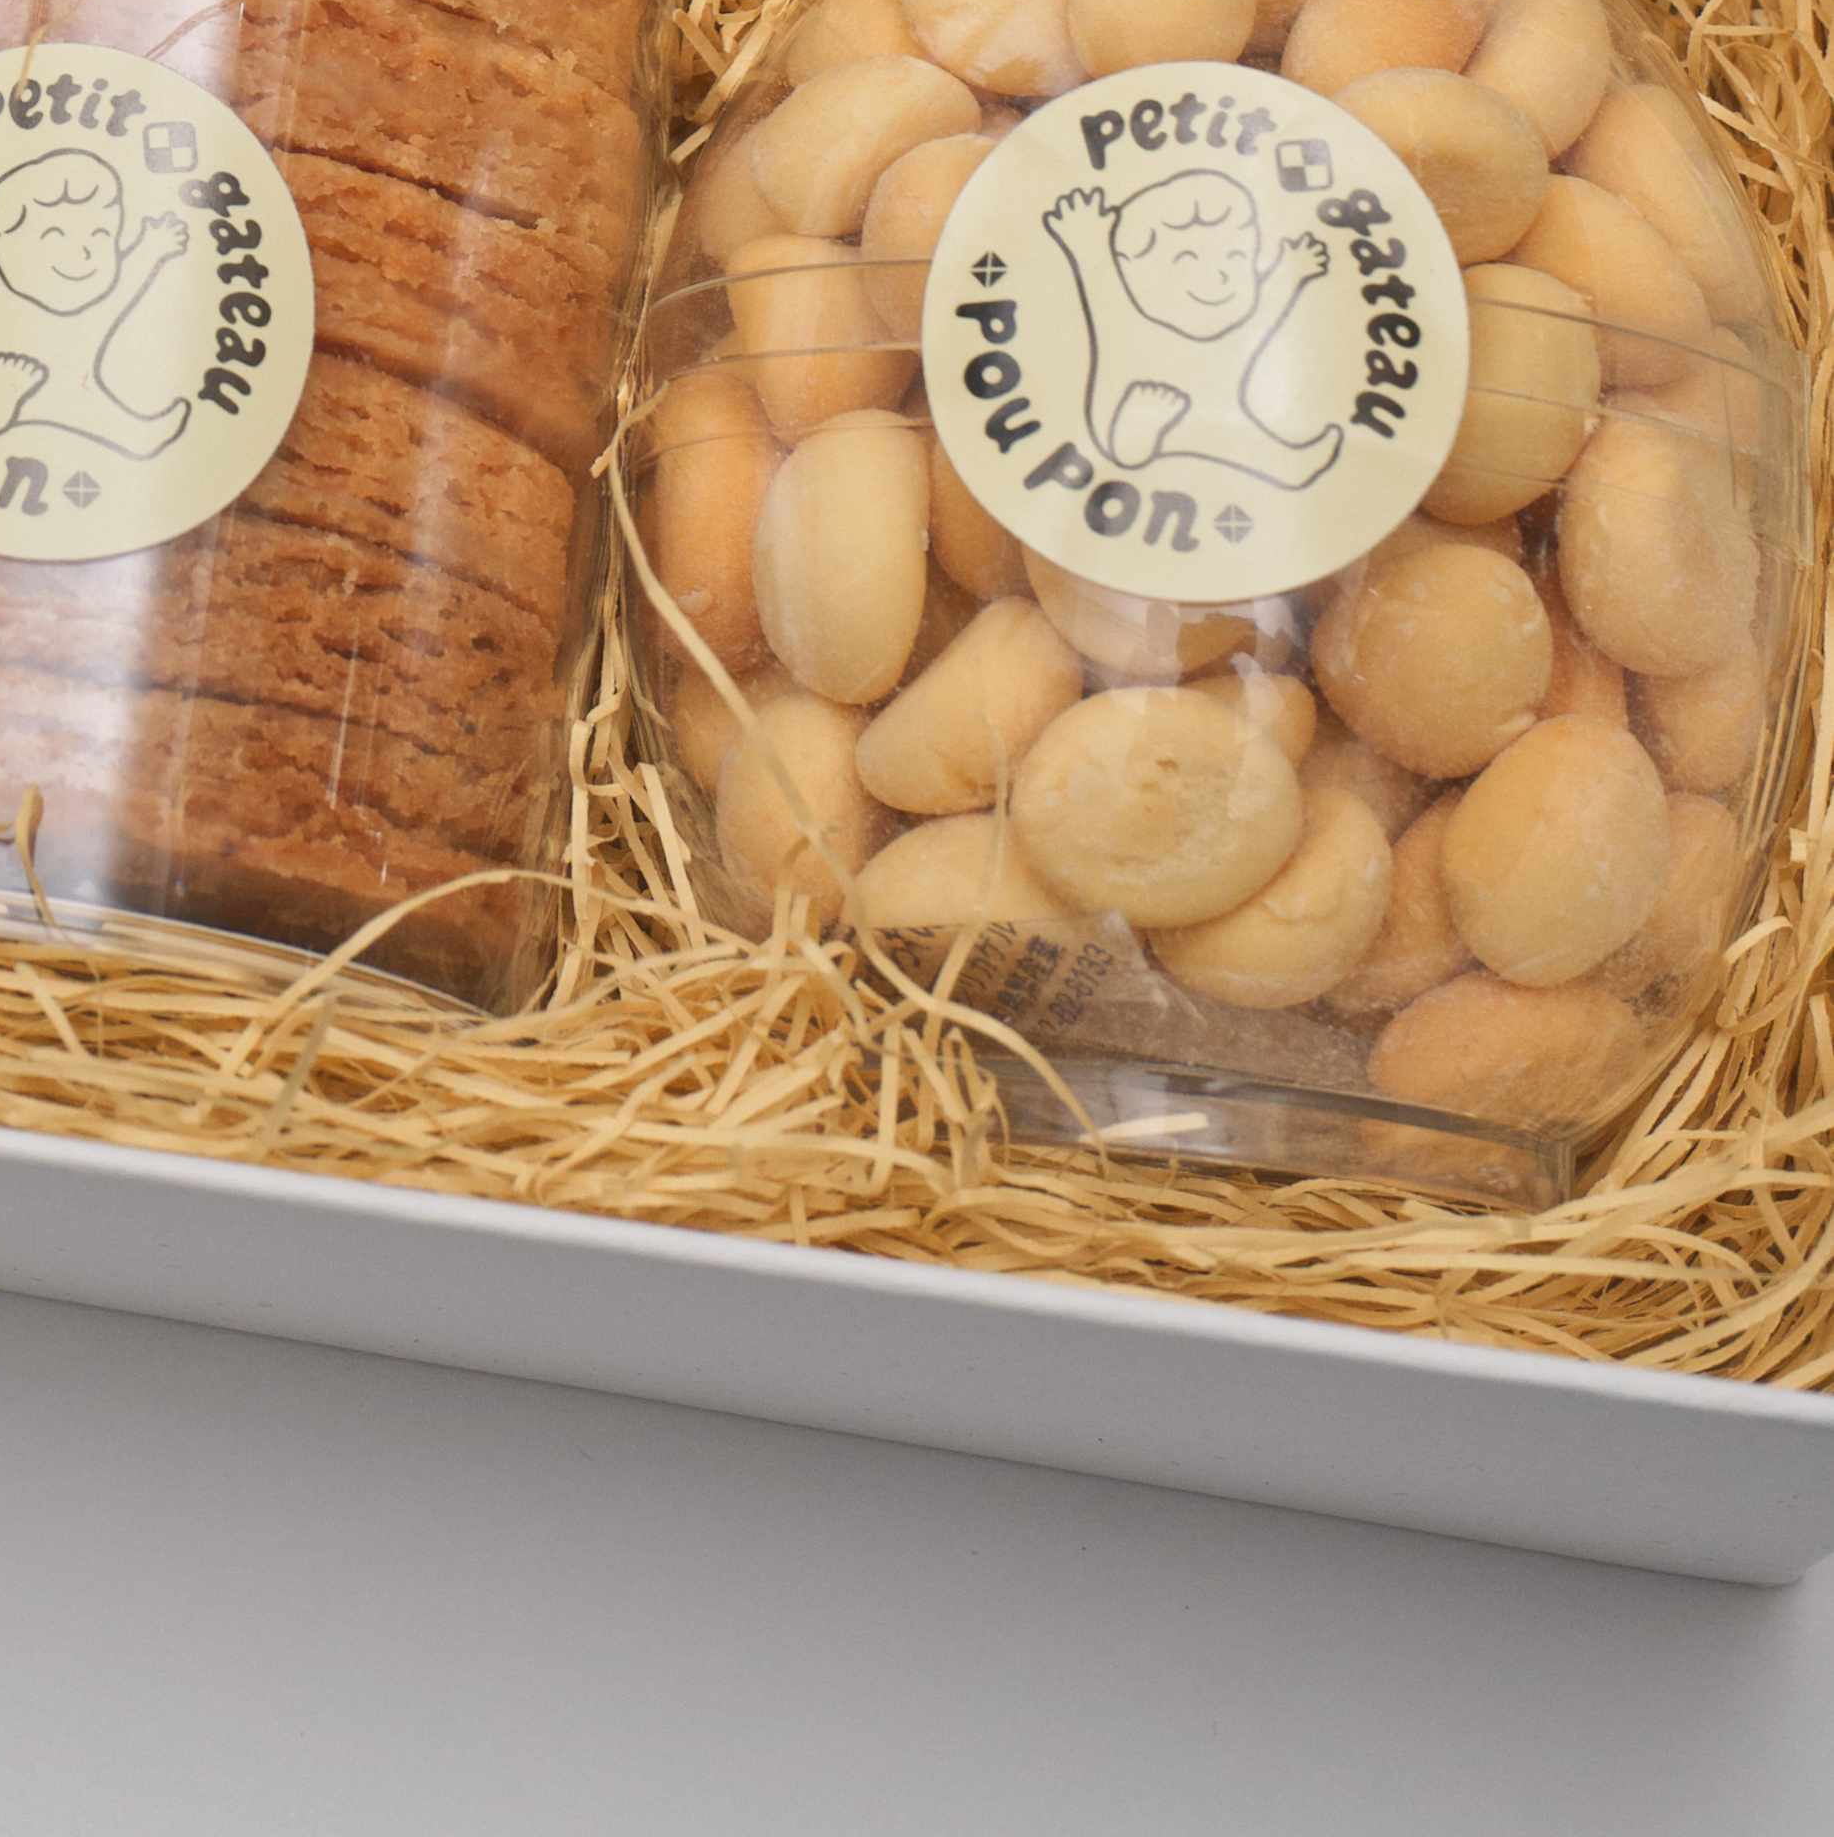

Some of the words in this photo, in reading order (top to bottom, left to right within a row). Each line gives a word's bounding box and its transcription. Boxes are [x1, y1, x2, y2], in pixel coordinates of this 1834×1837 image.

[178, 171, 272, 415] gateau
[1080, 92, 1278, 170] petit
[1316, 189, 1422, 439] gateau
[955, 299, 1041, 453] pou
[1023, 441, 1200, 553] pon
